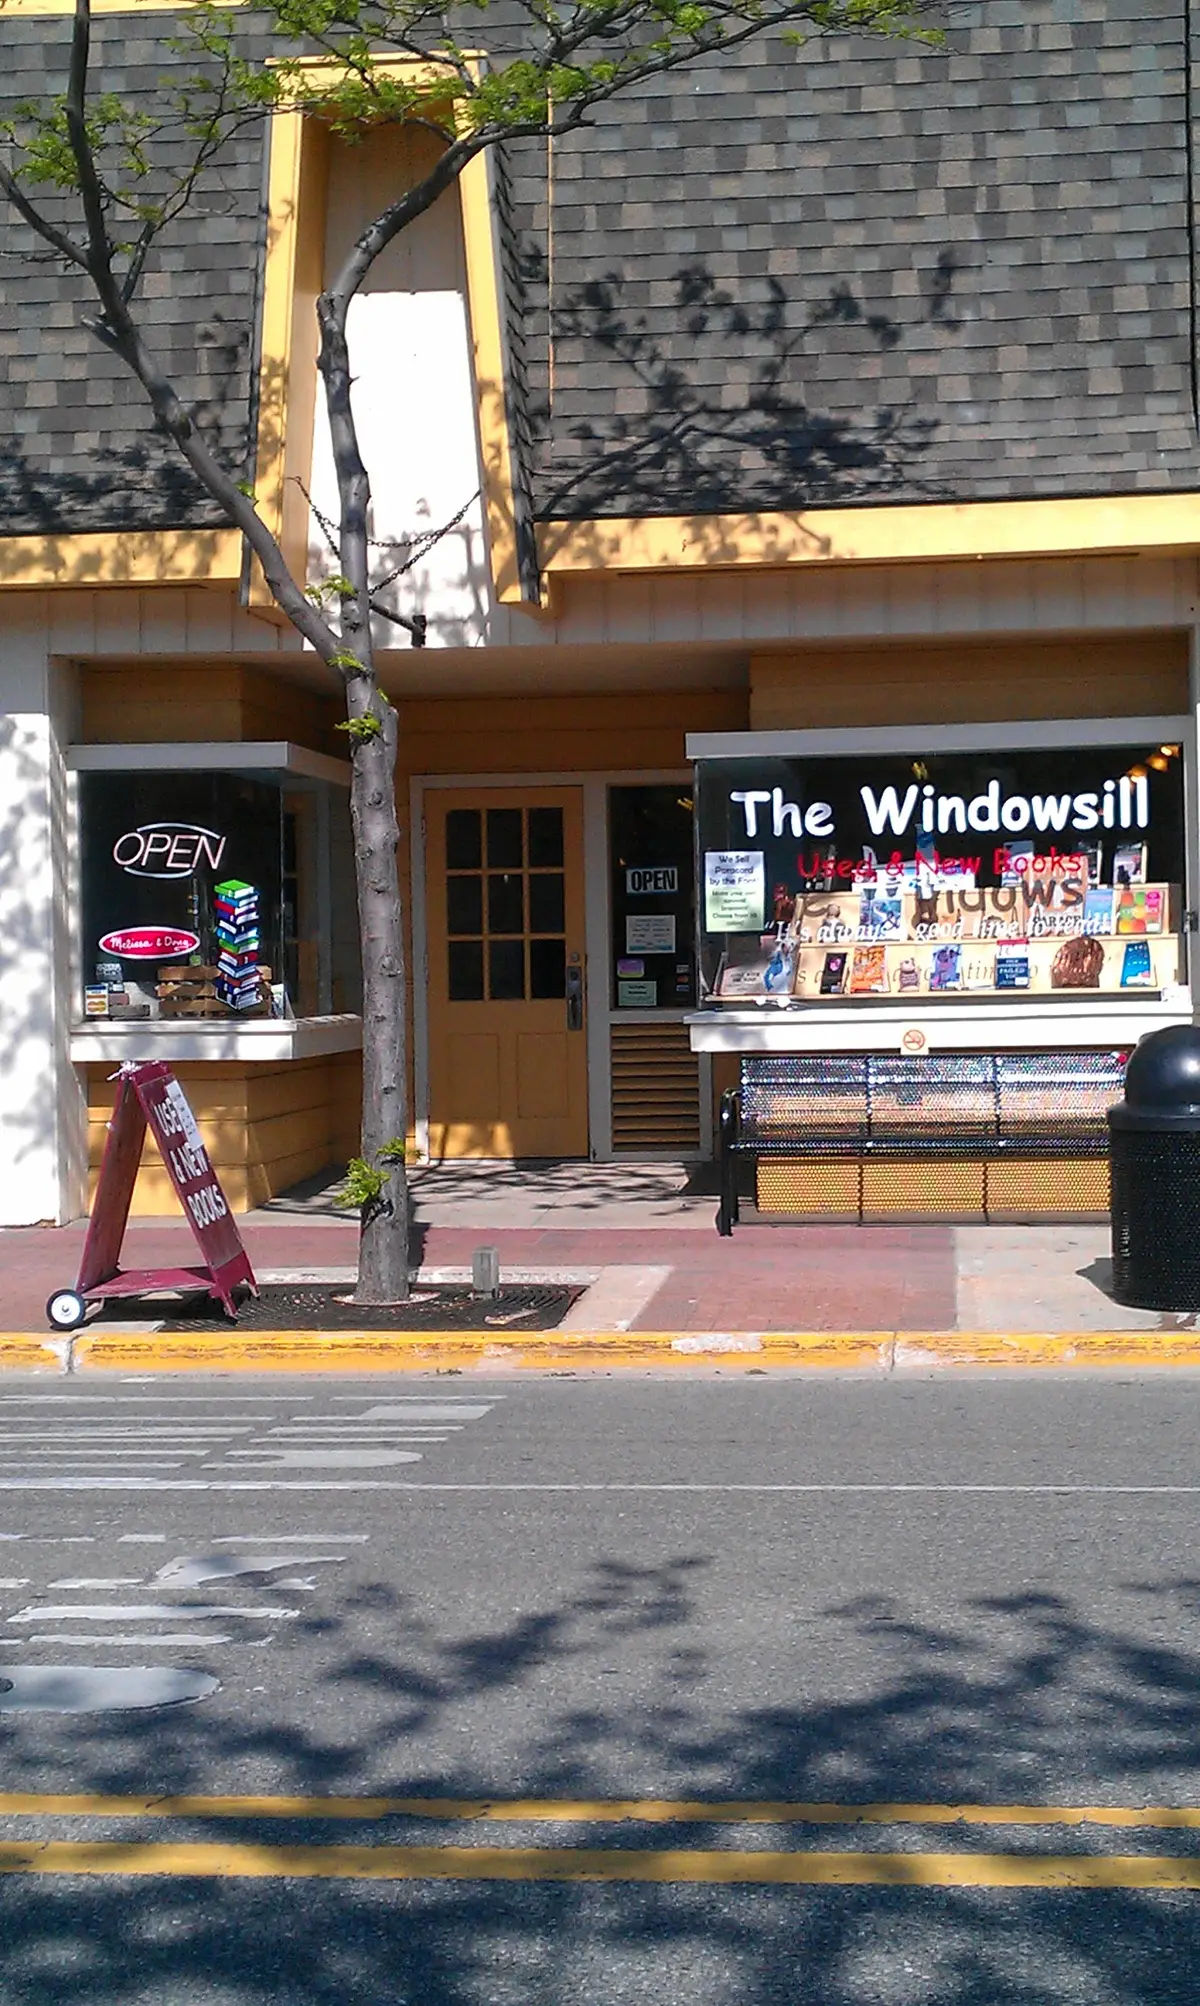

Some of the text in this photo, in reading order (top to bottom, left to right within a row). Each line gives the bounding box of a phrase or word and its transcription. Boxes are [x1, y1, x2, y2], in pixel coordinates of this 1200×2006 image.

[731, 776, 1150, 838] The Windowsill
[113, 832, 227, 870] OPEN
[718, 855, 750, 863] We Sell
[797, 846, 1084, 878] Used & New Books
[630, 869, 676, 891] OPEN
[722, 877, 736, 885] the
[109, 936, 153, 951] Melissa
[155, 937, 163, 947] &
[816, 919, 888, 949] always
[917, 915, 964, 942] good
[973, 915, 1019, 938] time
[1026, 911, 1046, 936] to
[153, 1096, 183, 1137] USE
[169, 1141, 209, 1184] & NEW
[187, 1184, 227, 1229] BOOKS
